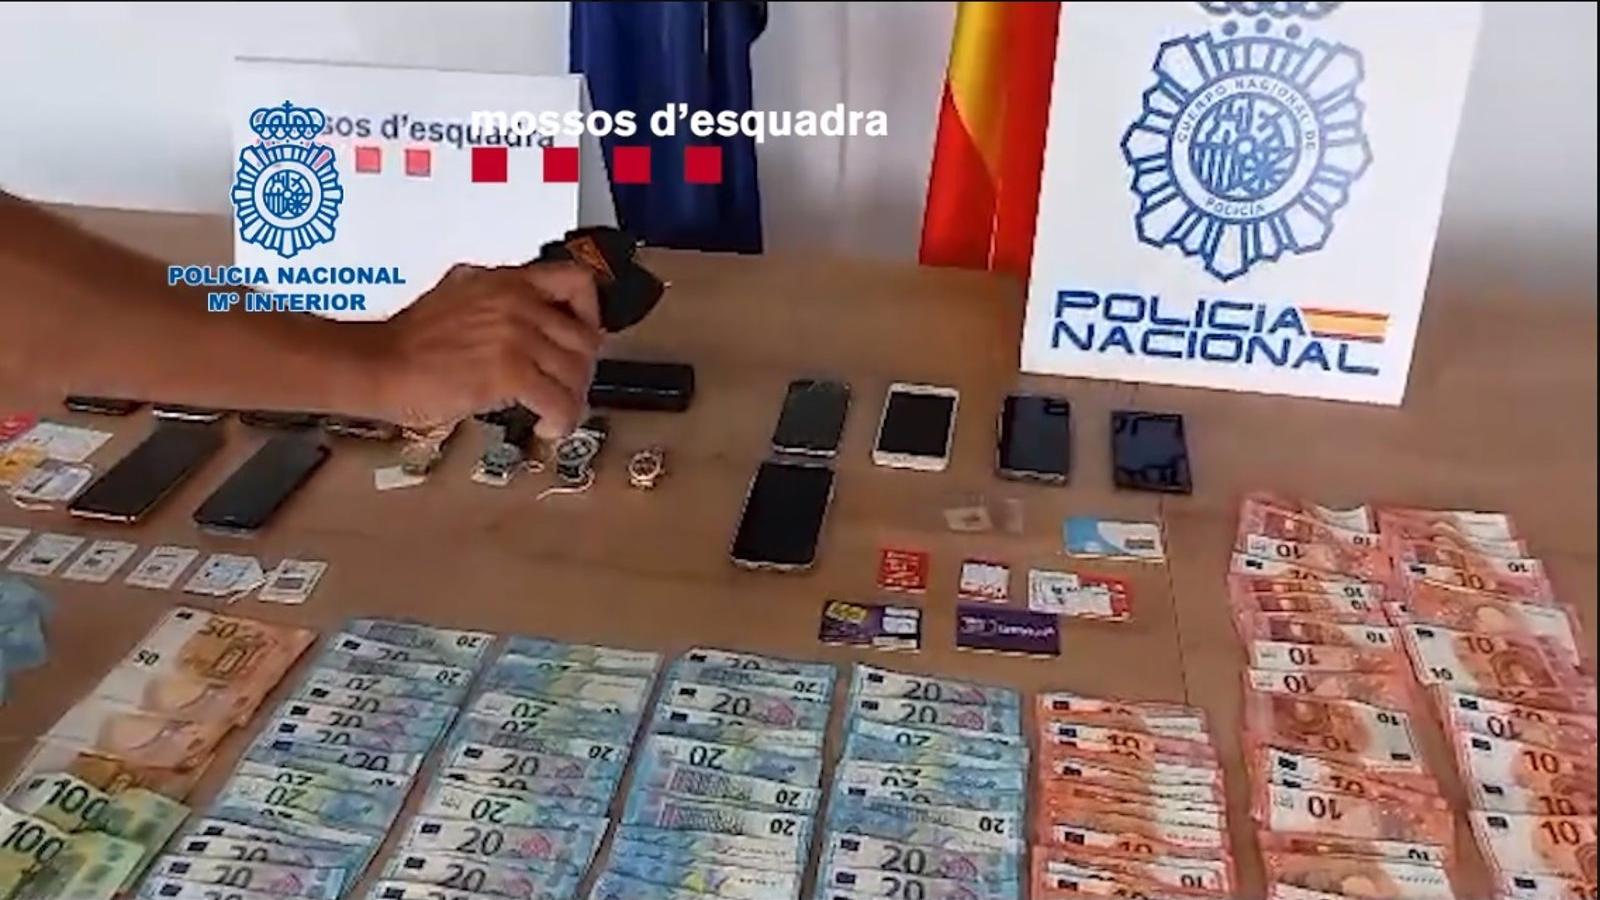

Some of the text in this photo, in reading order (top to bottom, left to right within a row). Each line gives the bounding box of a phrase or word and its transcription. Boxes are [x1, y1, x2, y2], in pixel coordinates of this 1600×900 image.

[1052, 321, 1379, 376] NACIONAL
[199, 619, 237, 638] 50
[1460, 636, 1494, 654] 10
[133, 649, 160, 666] 50
[1289, 647, 1319, 666] 10
[1284, 675, 1315, 693] 10
[1431, 667, 1453, 680] 10
[902, 680, 941, 701] 20
[710, 693, 750, 717] 20
[899, 703, 938, 723] 20
[1376, 712, 1400, 726] 10
[1487, 716, 1521, 739] 10
[1323, 735, 1357, 752] 10
[689, 745, 728, 769] 20
[1523, 750, 1559, 774] 10
[45, 778, 109, 821] 100
[775, 789, 801, 807] 20
[1308, 796, 1342, 819] 10
[770, 818, 796, 836] 20
[979, 816, 1005, 834] 20
[1541, 821, 1579, 845] 10
[1, 820, 64, 862] 100
[456, 827, 504, 856] 20
[881, 845, 926, 874] 20
[438, 864, 486, 892] 20
